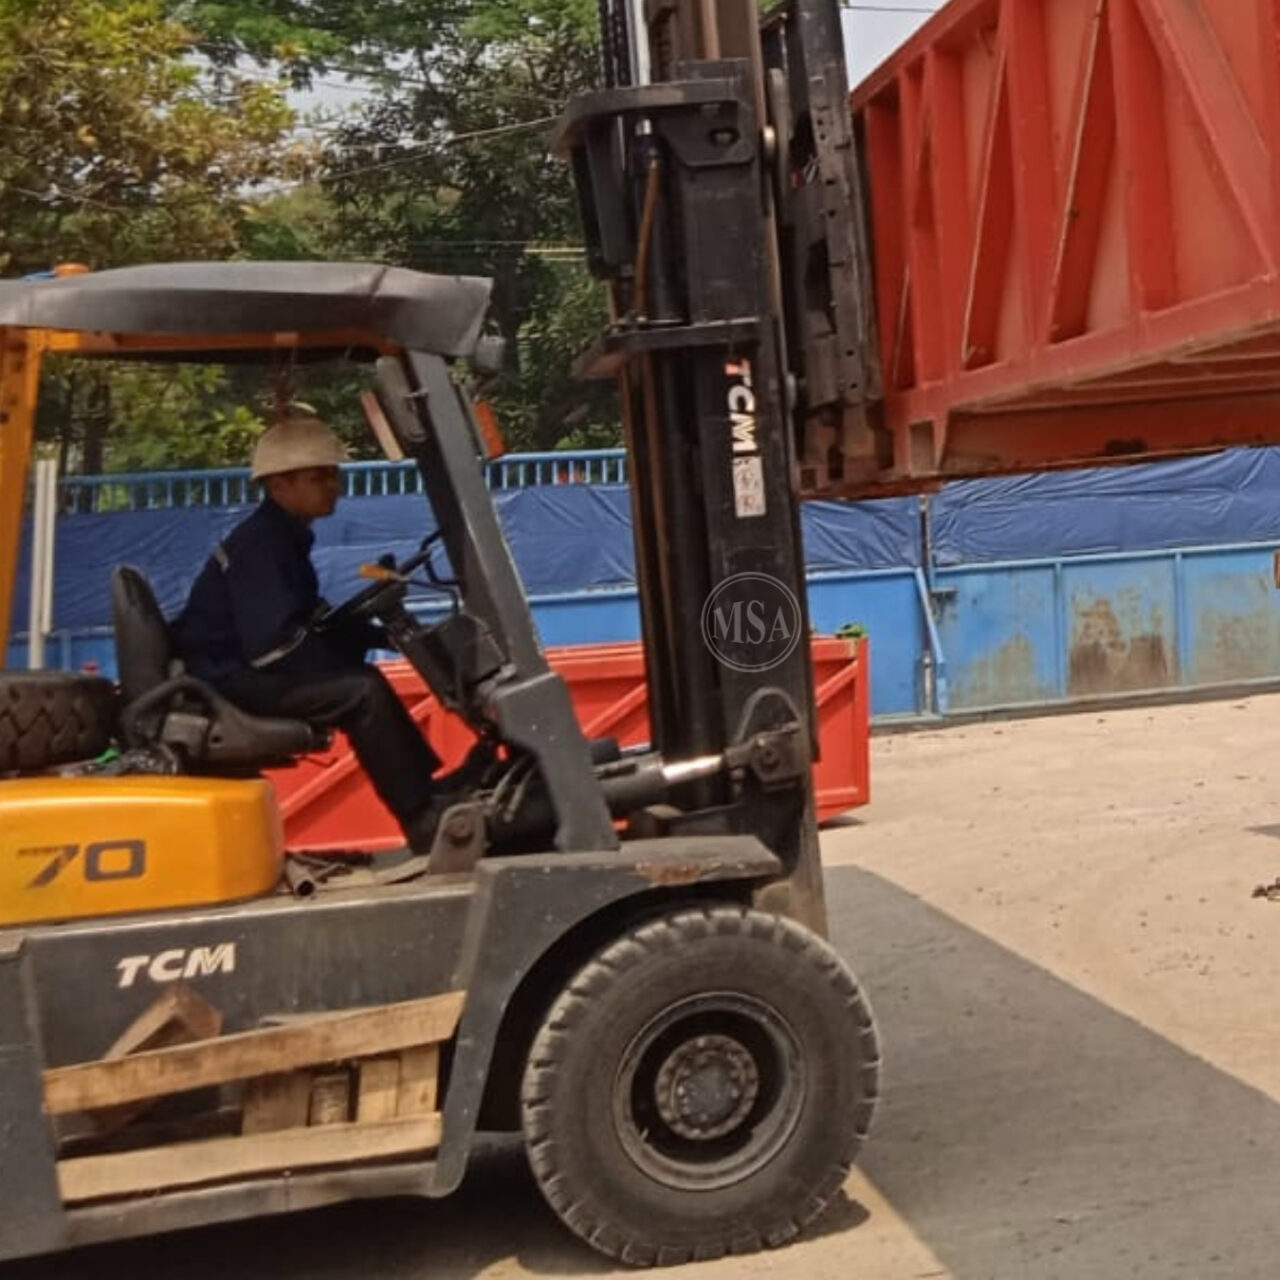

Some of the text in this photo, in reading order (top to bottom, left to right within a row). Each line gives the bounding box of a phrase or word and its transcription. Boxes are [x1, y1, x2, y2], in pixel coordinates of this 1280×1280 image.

[725, 358, 758, 453] TCM
[17, 838, 147, 889] 70
[115, 942, 237, 989] TCM
